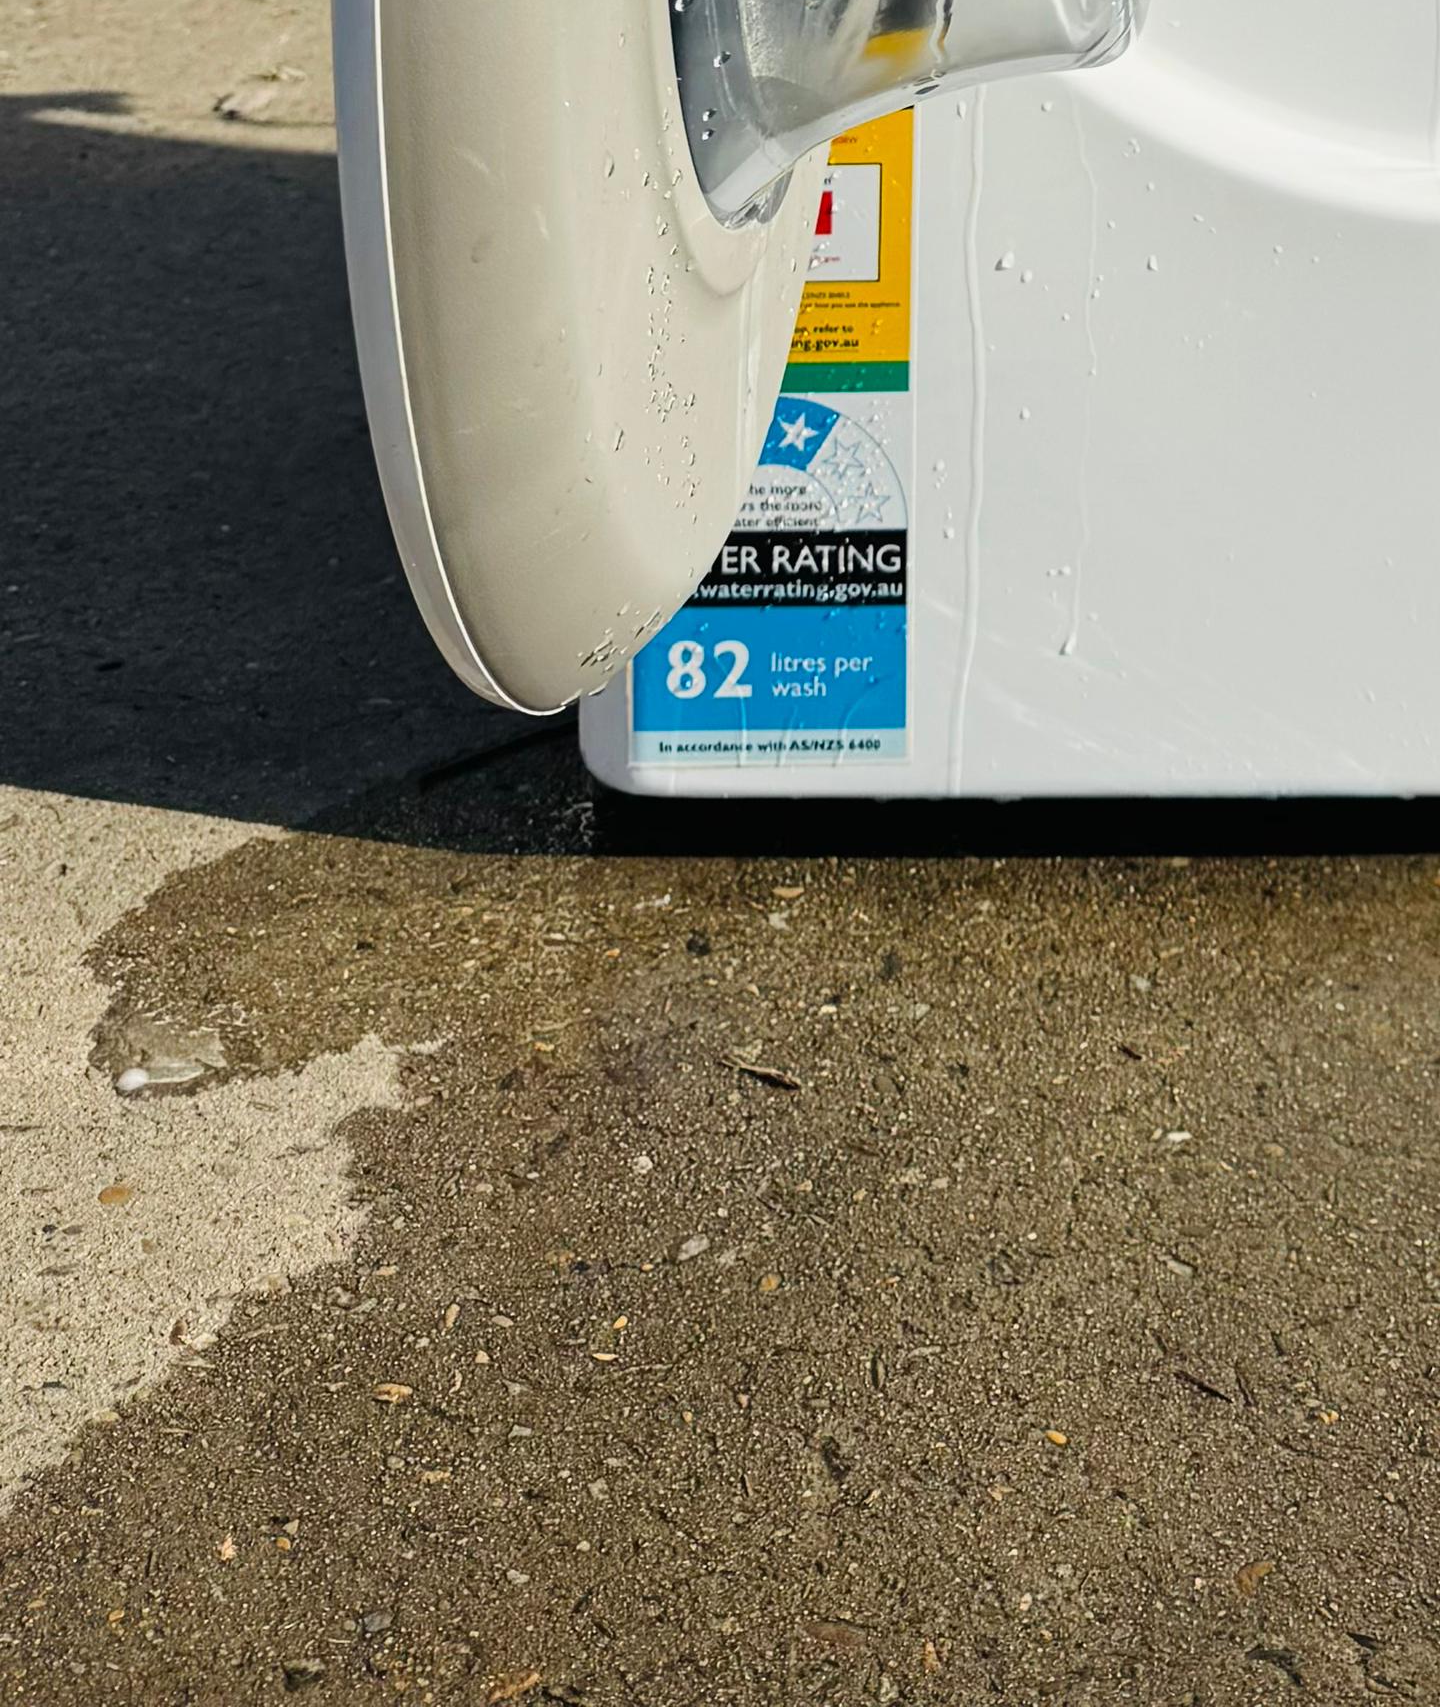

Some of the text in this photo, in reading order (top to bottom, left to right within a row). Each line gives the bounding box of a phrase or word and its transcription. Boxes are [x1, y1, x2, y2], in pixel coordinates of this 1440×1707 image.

[813, 324, 839, 333] refer
[842, 325, 854, 333] to
[791, 339, 859, 352] ing.gov.au
[749, 483, 765, 495] he
[734, 518, 760, 527] ater
[721, 544, 901, 574] ER RATING
[694, 579, 903, 602] .waterrating.gov.au
[666, 640, 752, 699] 82
[771, 652, 873, 678] litres per
[771, 675, 827, 697] wash
[659, 742, 672, 753] In
